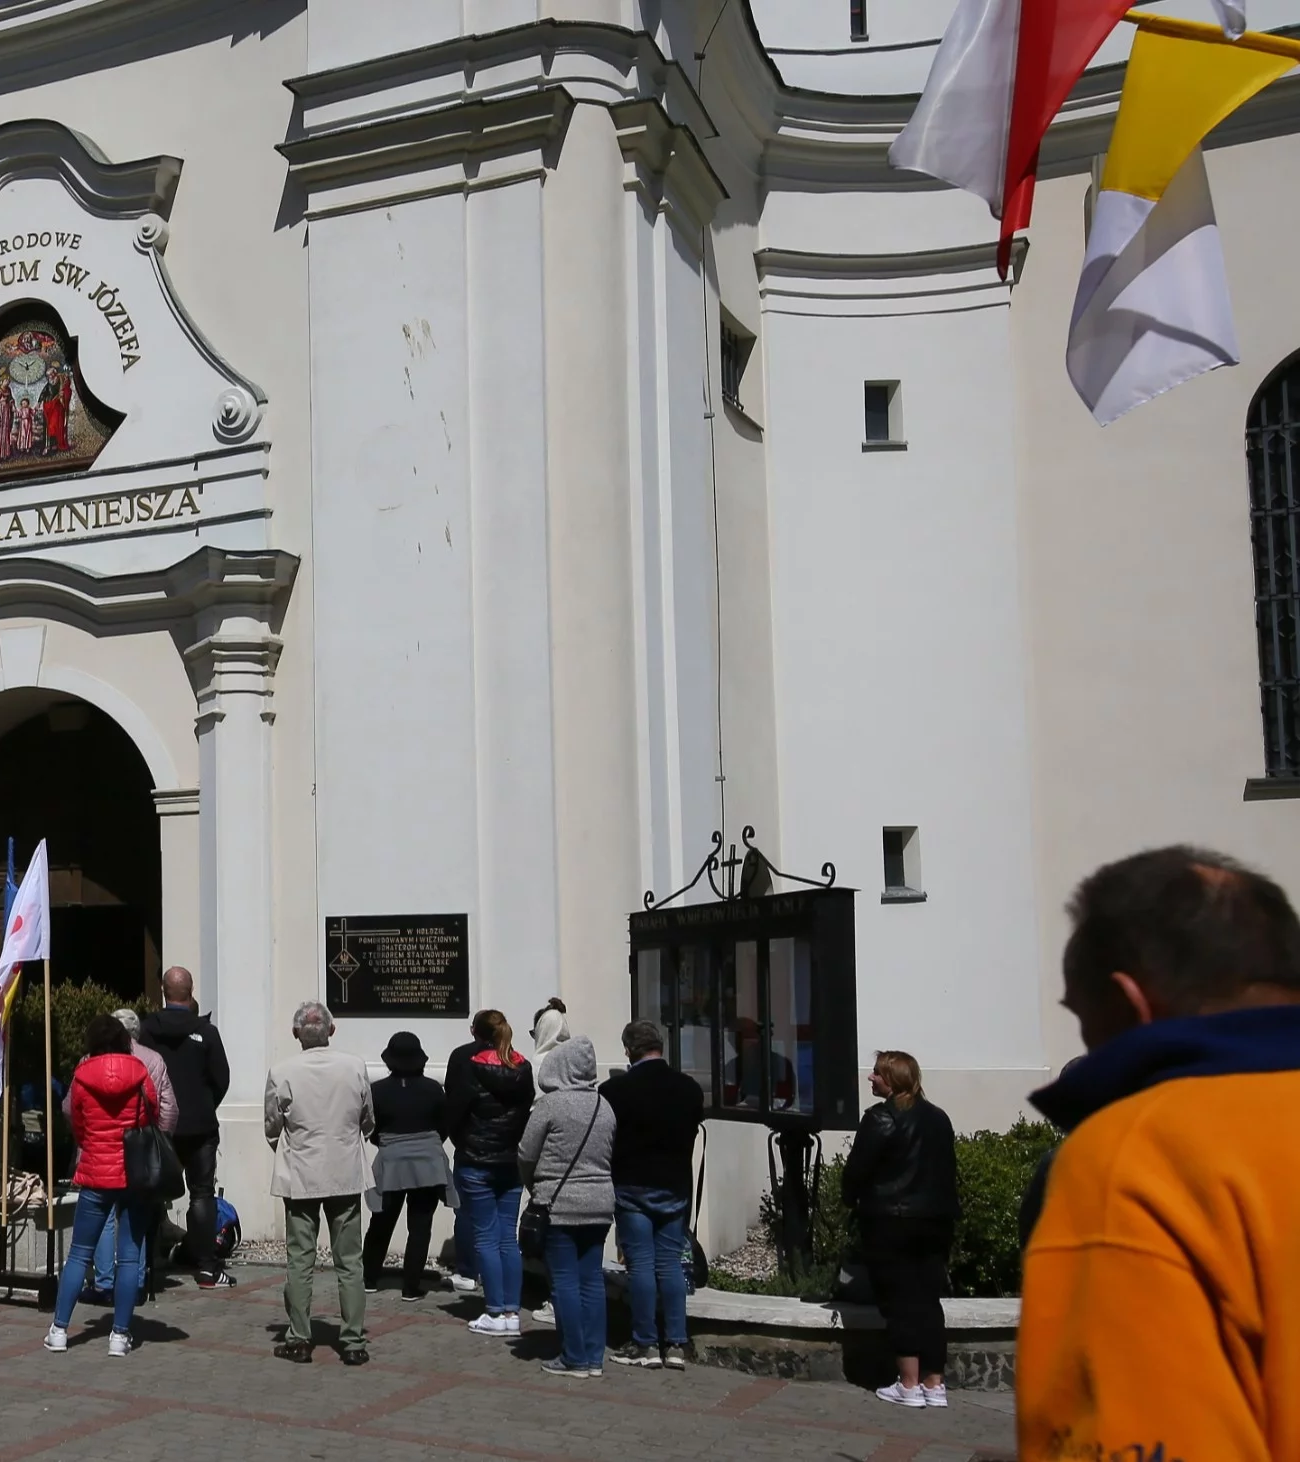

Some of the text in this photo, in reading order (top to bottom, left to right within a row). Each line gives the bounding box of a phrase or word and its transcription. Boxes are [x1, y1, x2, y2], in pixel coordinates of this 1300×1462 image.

[51, 255, 90, 293] ŚW.
[87, 280, 142, 374] JÓZEFA
[34, 487, 202, 536] MNIEJSZA
[419, 943, 438, 951] WALK
[381, 966, 408, 974] LATACH
